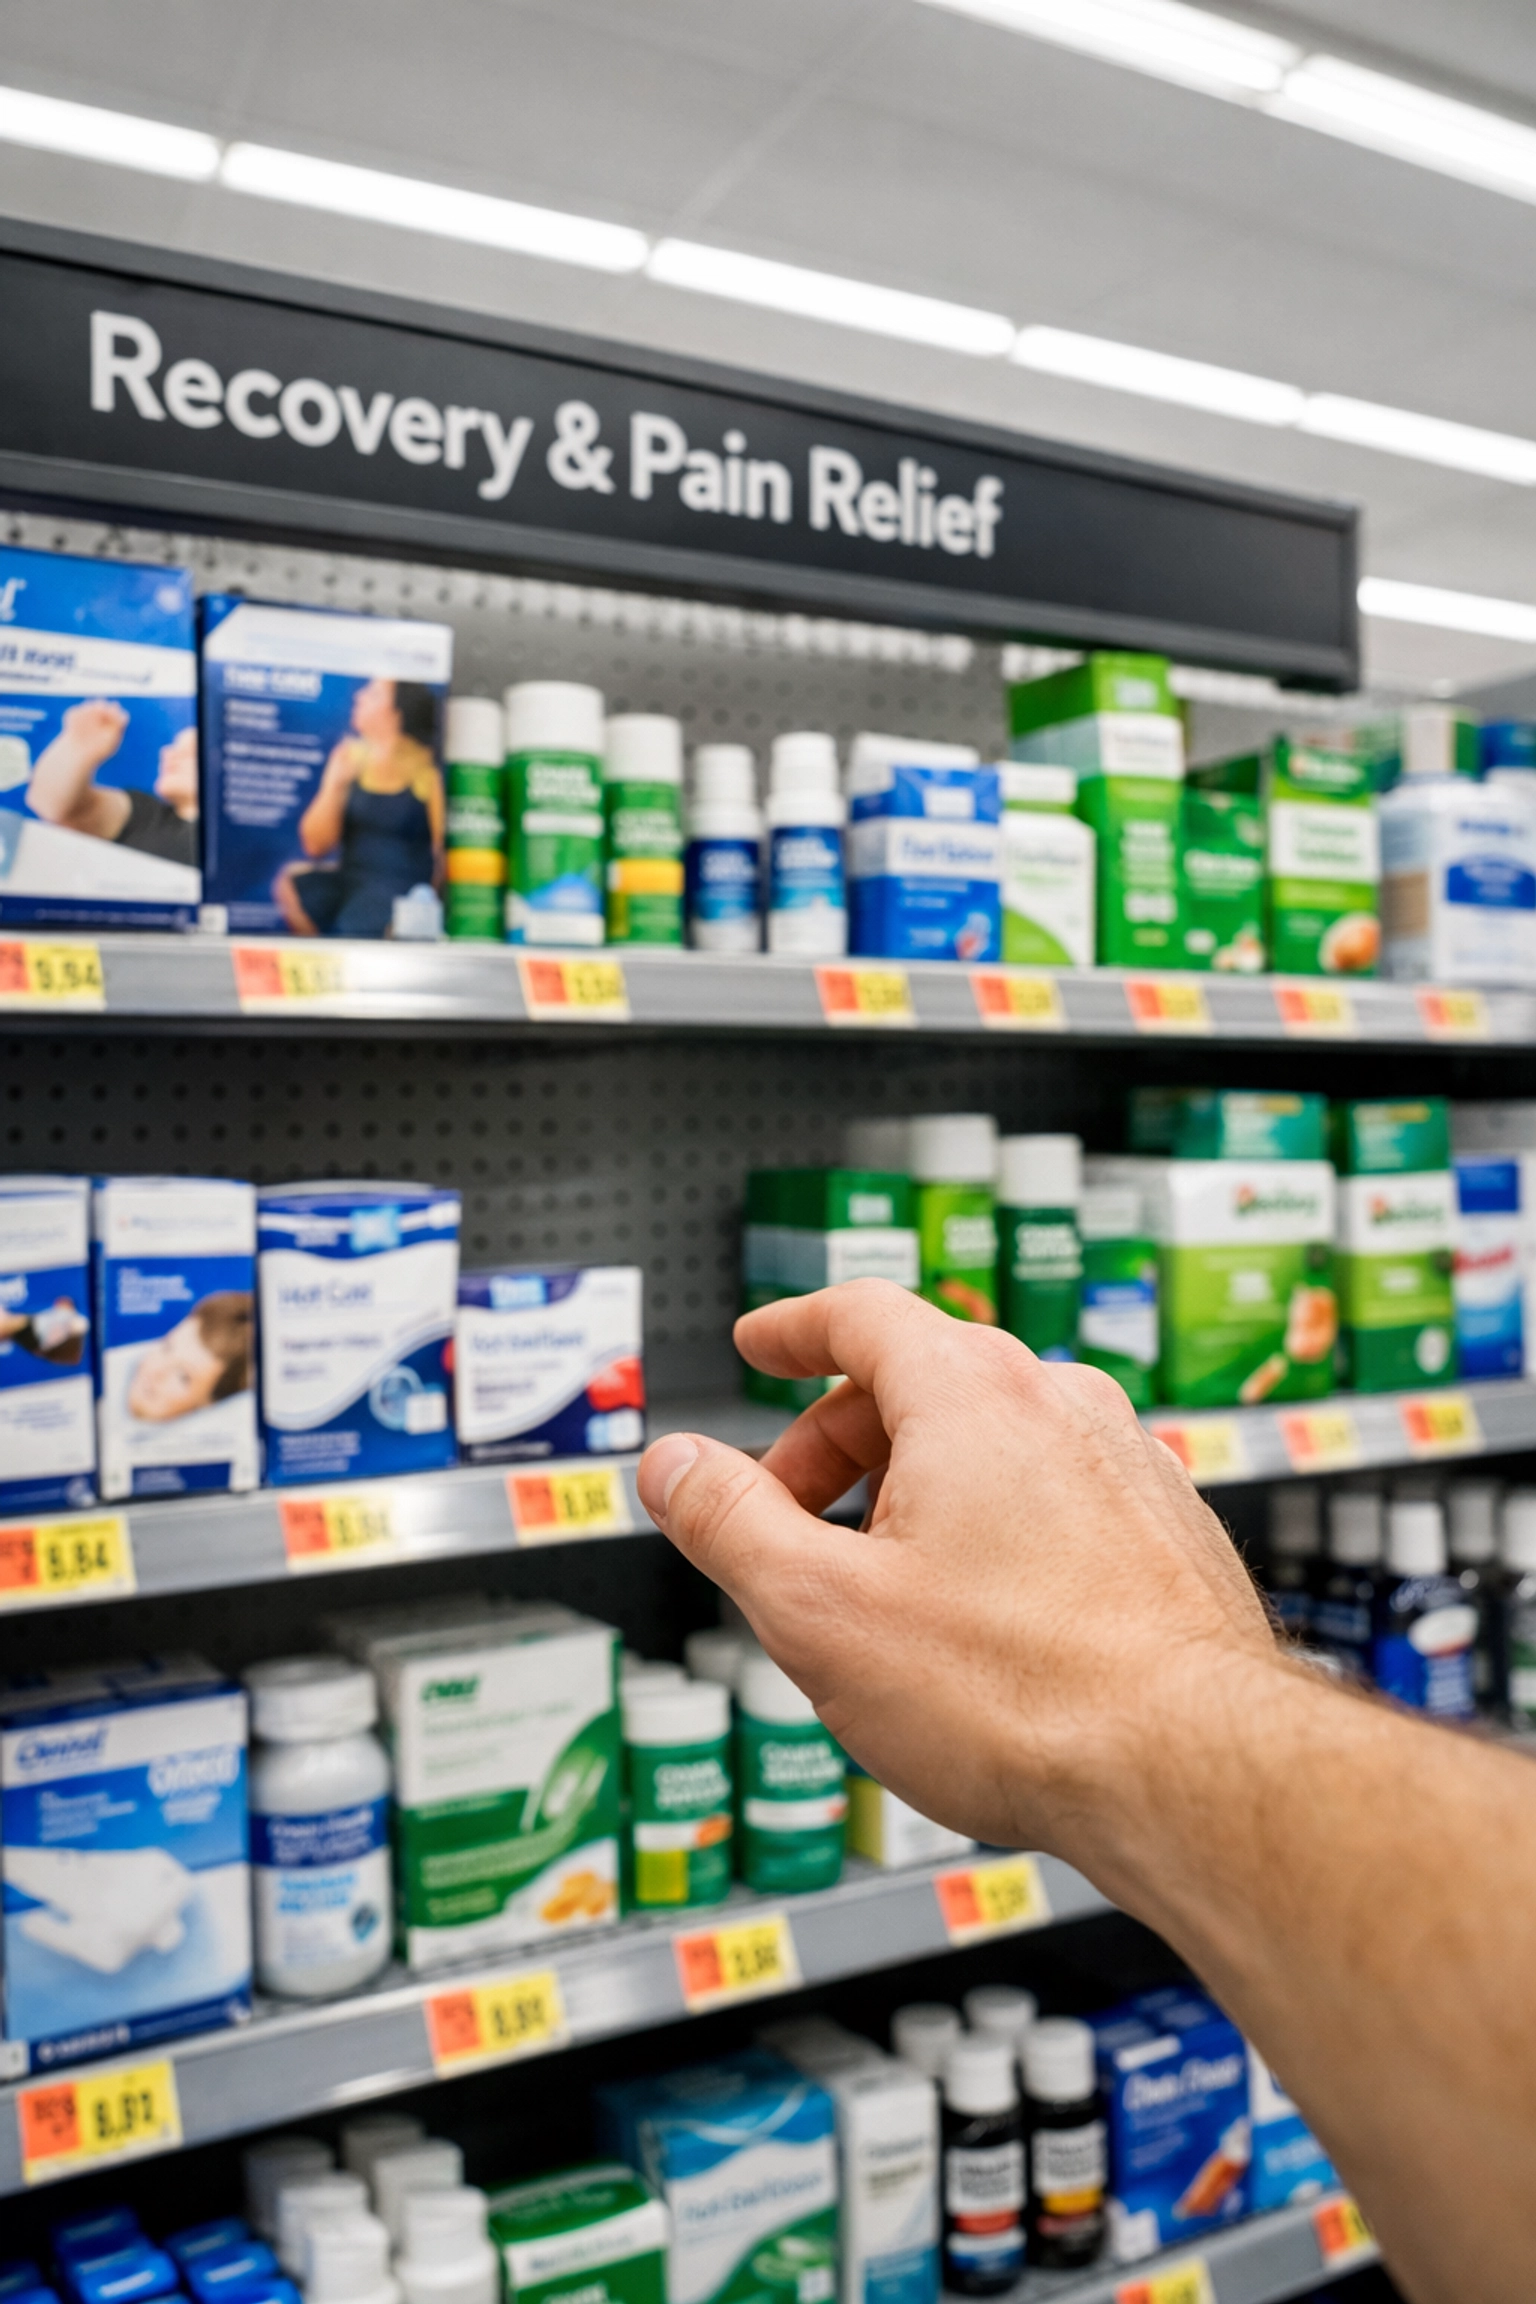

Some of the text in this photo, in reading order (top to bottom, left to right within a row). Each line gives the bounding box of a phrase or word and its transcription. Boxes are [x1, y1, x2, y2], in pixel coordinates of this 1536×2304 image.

[90, 309, 1003, 557] Recovery & Pain Relief
